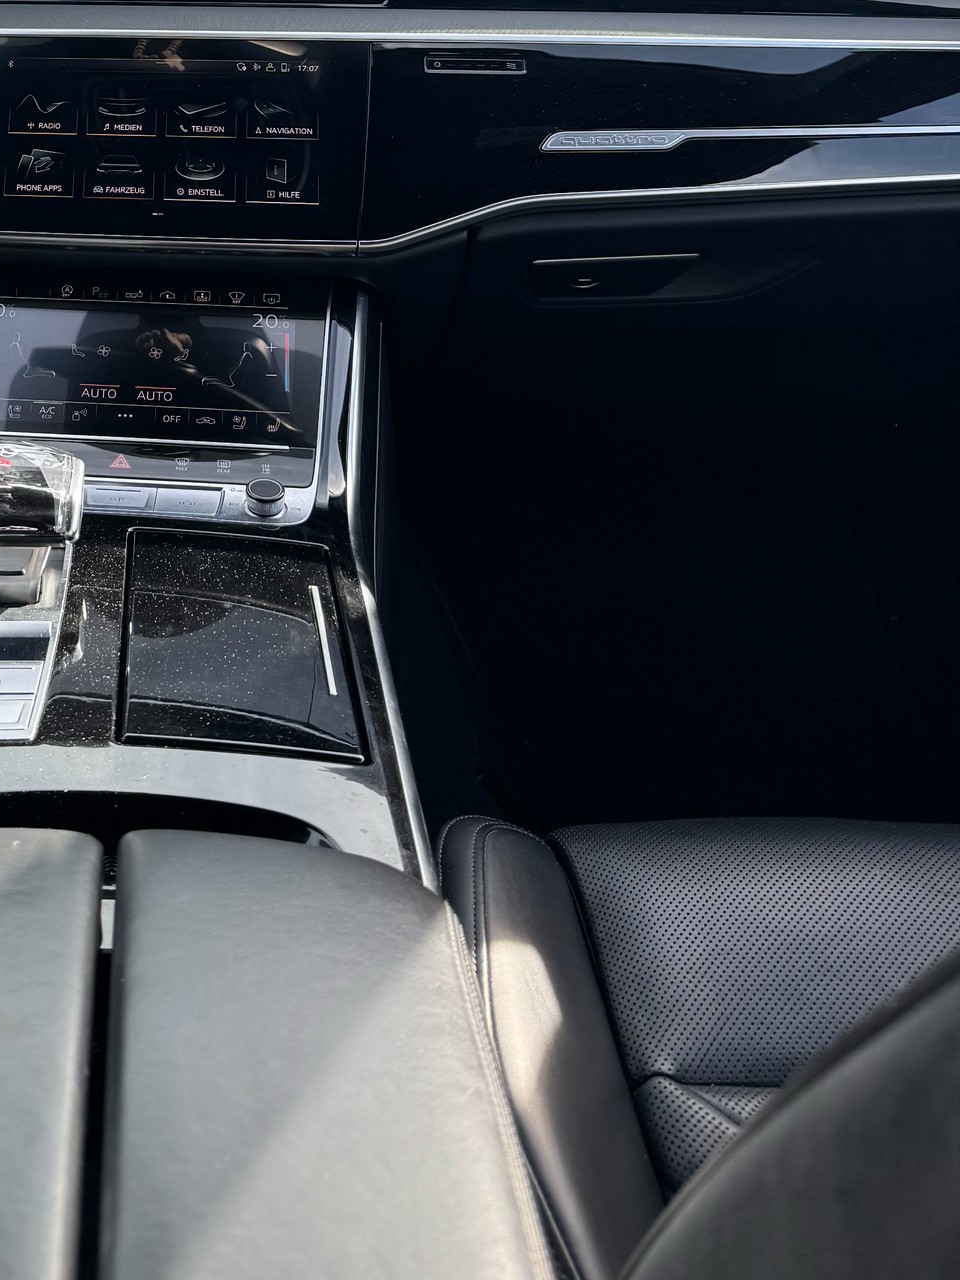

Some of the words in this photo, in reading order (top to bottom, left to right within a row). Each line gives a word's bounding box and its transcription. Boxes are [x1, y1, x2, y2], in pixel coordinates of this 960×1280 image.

[297, 64, 319, 73] 17:07
[38, 122, 61, 130] RADIO
[113, 123, 143, 132] MEDIEN
[191, 125, 225, 134] TELEFON
[265, 127, 313, 136] NAVIGATION
[560, 134, 668, 147] quattro
[16, 183, 42, 192] PHONE
[43, 184, 62, 193] APPS
[105, 186, 145, 195] FAHRZEUG
[188, 188, 225, 197] EINSTELL.
[278, 191, 301, 199] HILFE
[80, 388, 118, 399] AUTO
[136, 390, 174, 402] AUTO
[39, 406, 56, 415] A/C
[162, 414, 182, 423] OFF
